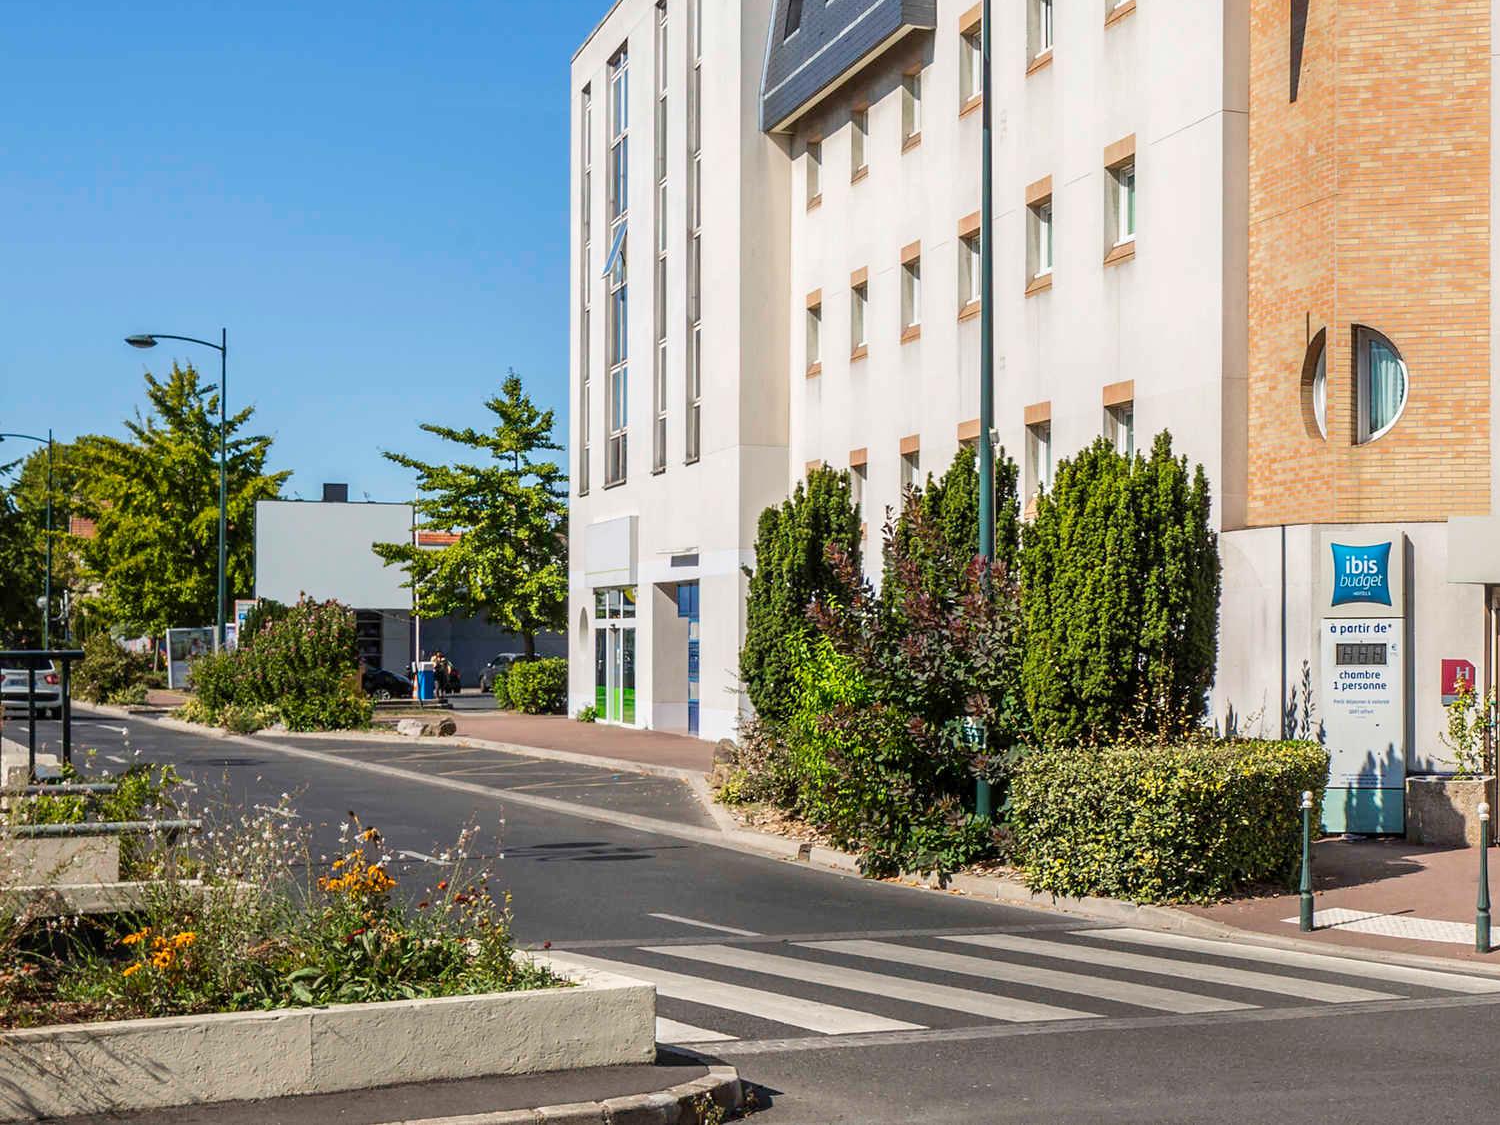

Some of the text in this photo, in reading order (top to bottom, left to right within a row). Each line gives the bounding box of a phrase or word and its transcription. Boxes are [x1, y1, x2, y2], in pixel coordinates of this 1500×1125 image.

[1345, 555, 1378, 574] ibis
[1340, 574, 1383, 590] budget
[1340, 623, 1370, 635] partir
[1339, 670, 1381, 680] chambre
[1332, 681, 1387, 691] 1 personne
